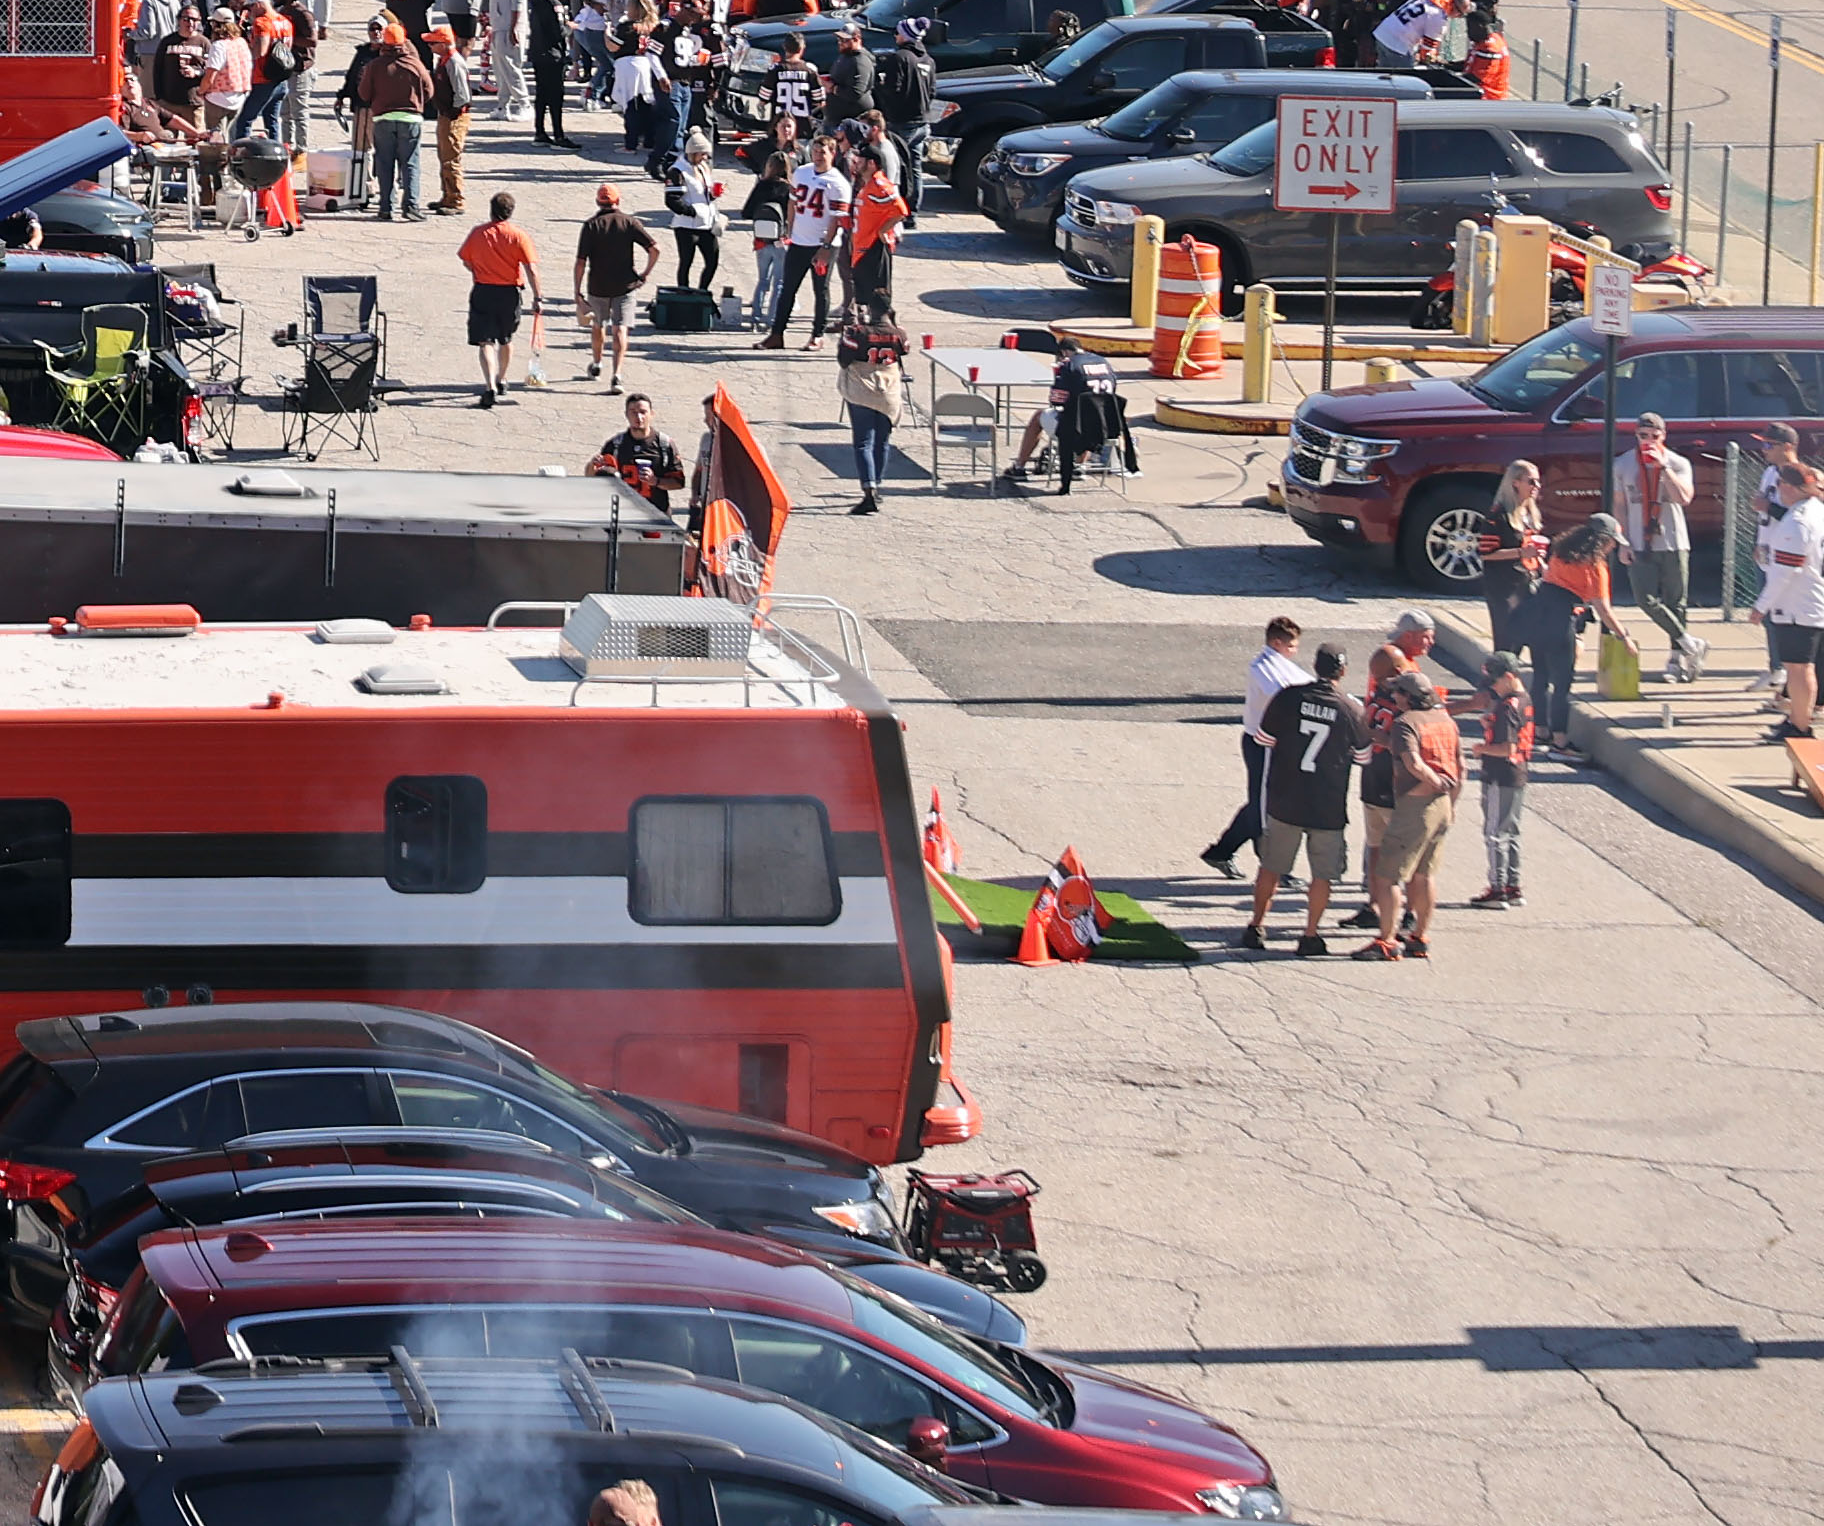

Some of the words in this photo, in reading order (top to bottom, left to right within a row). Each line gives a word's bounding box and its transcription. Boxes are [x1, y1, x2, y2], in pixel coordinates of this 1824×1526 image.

[776, 81, 809, 117] 95
[1301, 108, 1373, 138] EXIT
[1294, 143, 1379, 173] ONLY
[795, 183, 824, 218] 24
[1595, 286, 1627, 298] PARKING
[1604, 274, 1619, 285] NO
[1602, 309, 1619, 319] TIME
[1604, 300, 1618, 308] ANY
[1300, 701, 1337, 722] GILLAN
[1299, 718, 1331, 773] 7
